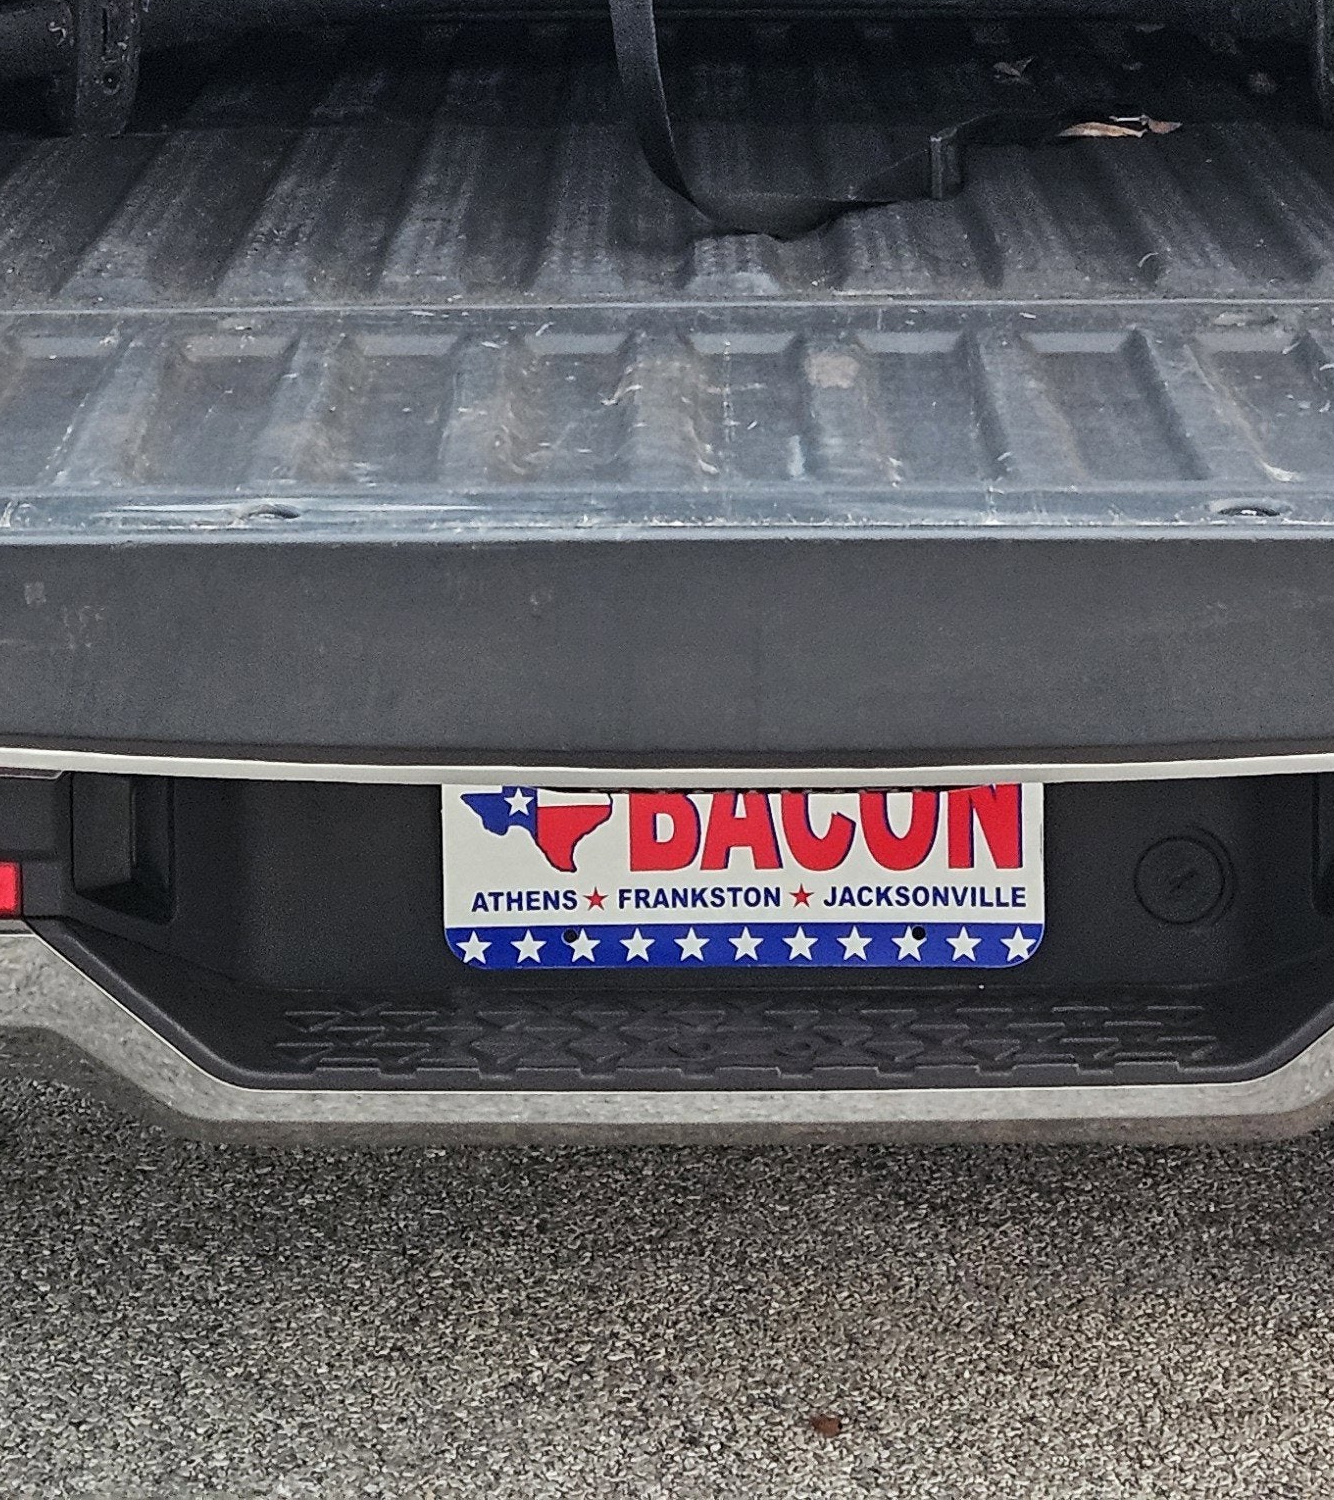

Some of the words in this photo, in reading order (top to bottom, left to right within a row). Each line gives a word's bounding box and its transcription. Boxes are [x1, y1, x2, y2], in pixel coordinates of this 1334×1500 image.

[471, 890, 578, 912] ATHENS
[618, 887, 781, 909] FRANKSTON
[823, 886, 1027, 908] JACKSONVILLE
